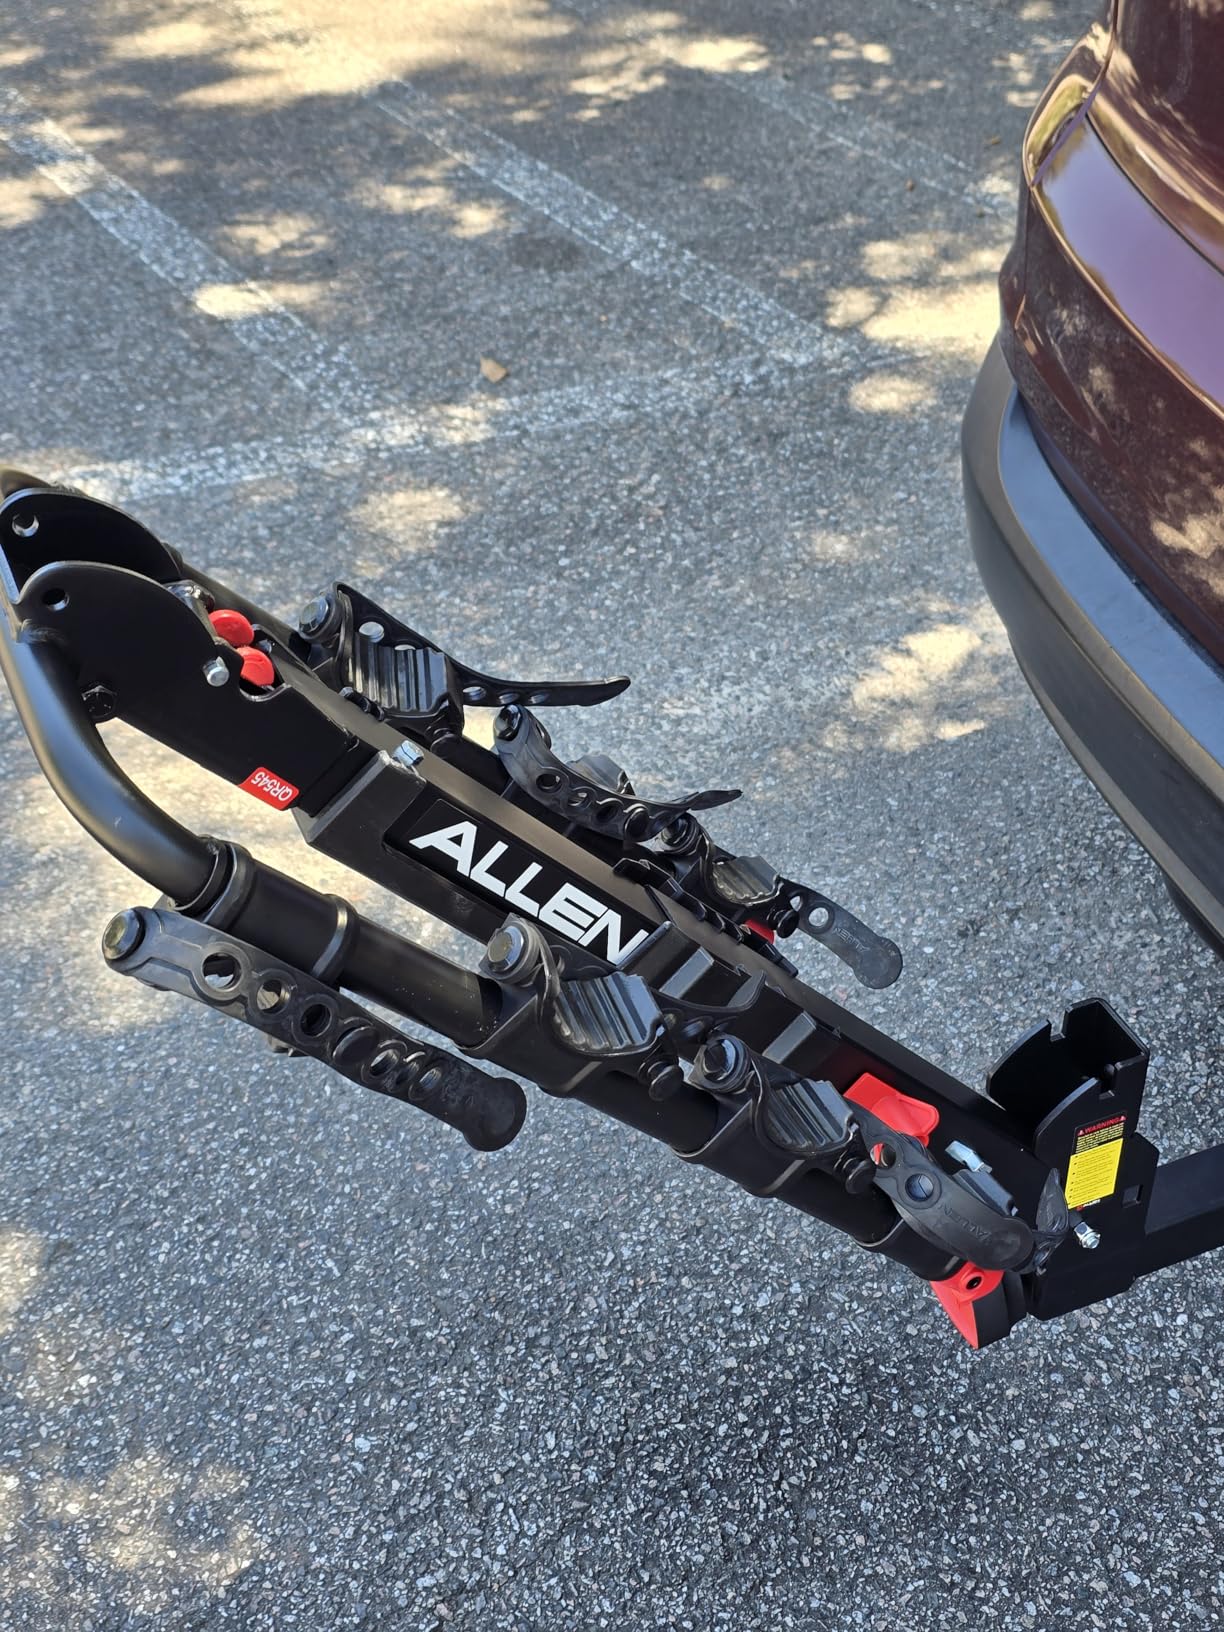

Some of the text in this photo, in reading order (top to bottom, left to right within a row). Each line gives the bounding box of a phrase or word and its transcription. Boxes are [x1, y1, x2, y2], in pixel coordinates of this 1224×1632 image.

[251, 771, 293, 802] QR545
[409, 820, 650, 966] ALLEN
[1085, 1116, 1121, 1134] WARNING
